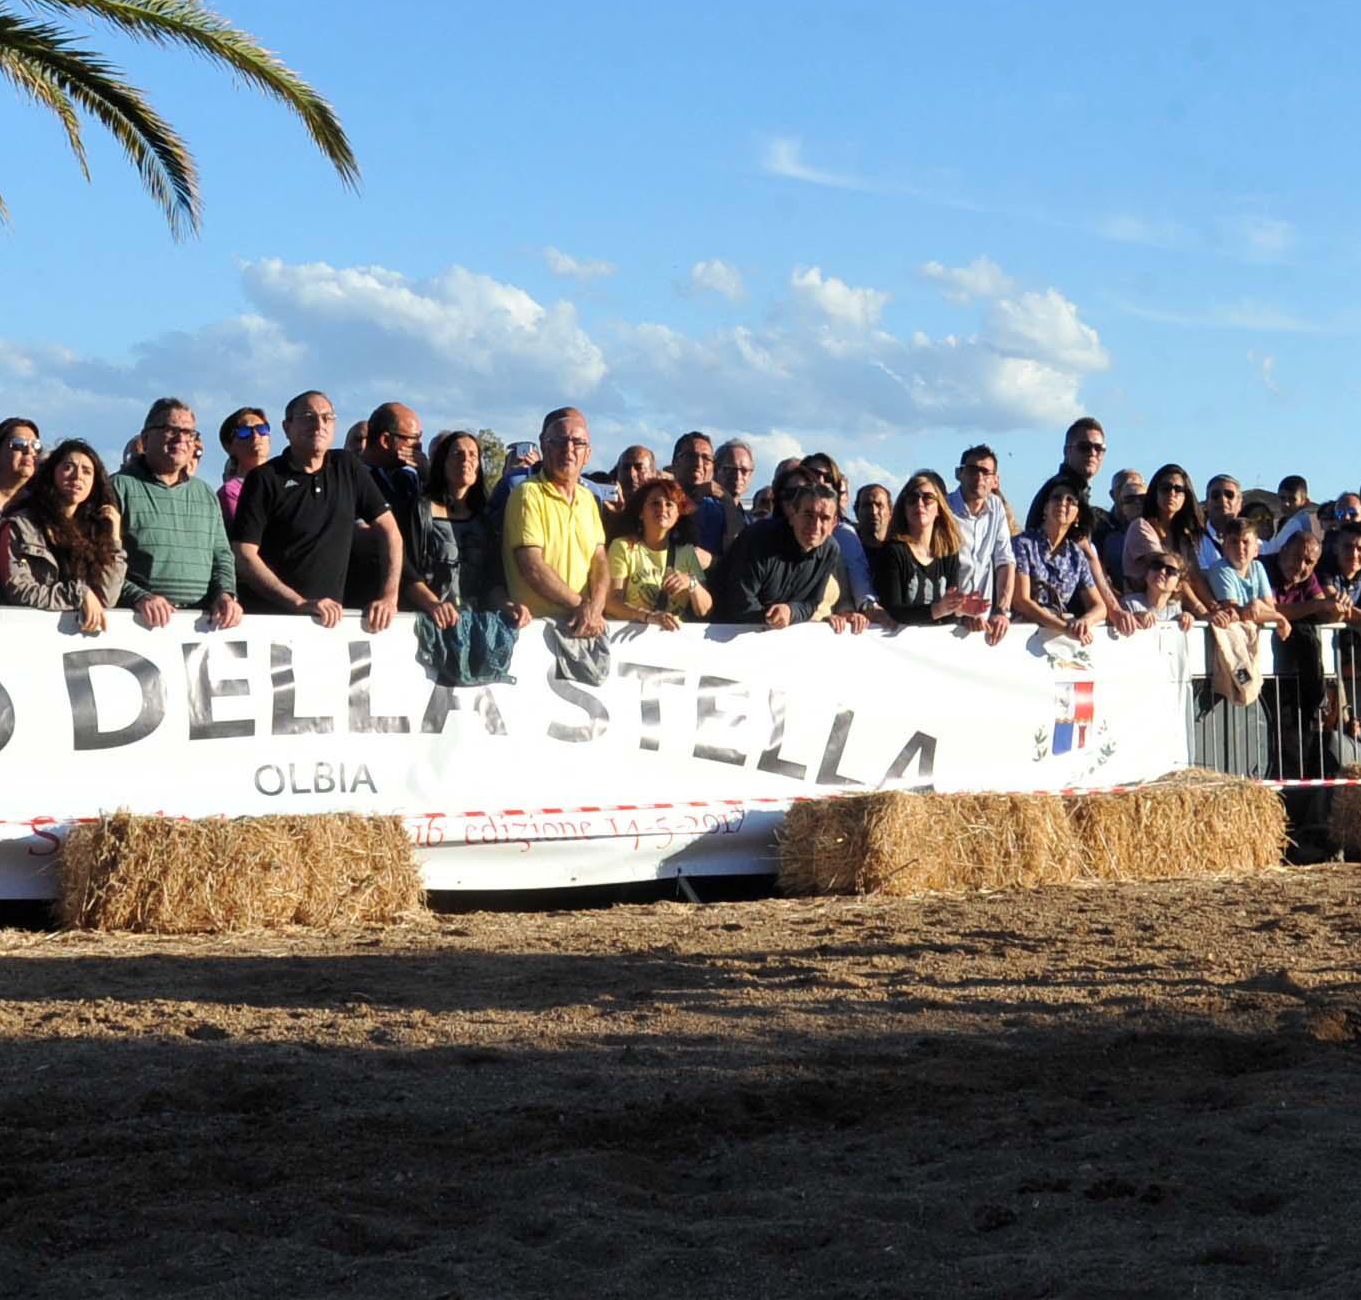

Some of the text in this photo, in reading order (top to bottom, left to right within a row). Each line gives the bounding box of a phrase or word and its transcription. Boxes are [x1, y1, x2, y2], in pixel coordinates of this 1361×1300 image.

[63, 640, 507, 750] DELLA
[546, 661, 938, 792] STELLA
[254, 761, 378, 796] OLBIA
[464, 812, 592, 853] edizione
[605, 806, 746, 851] 14-5-2017
